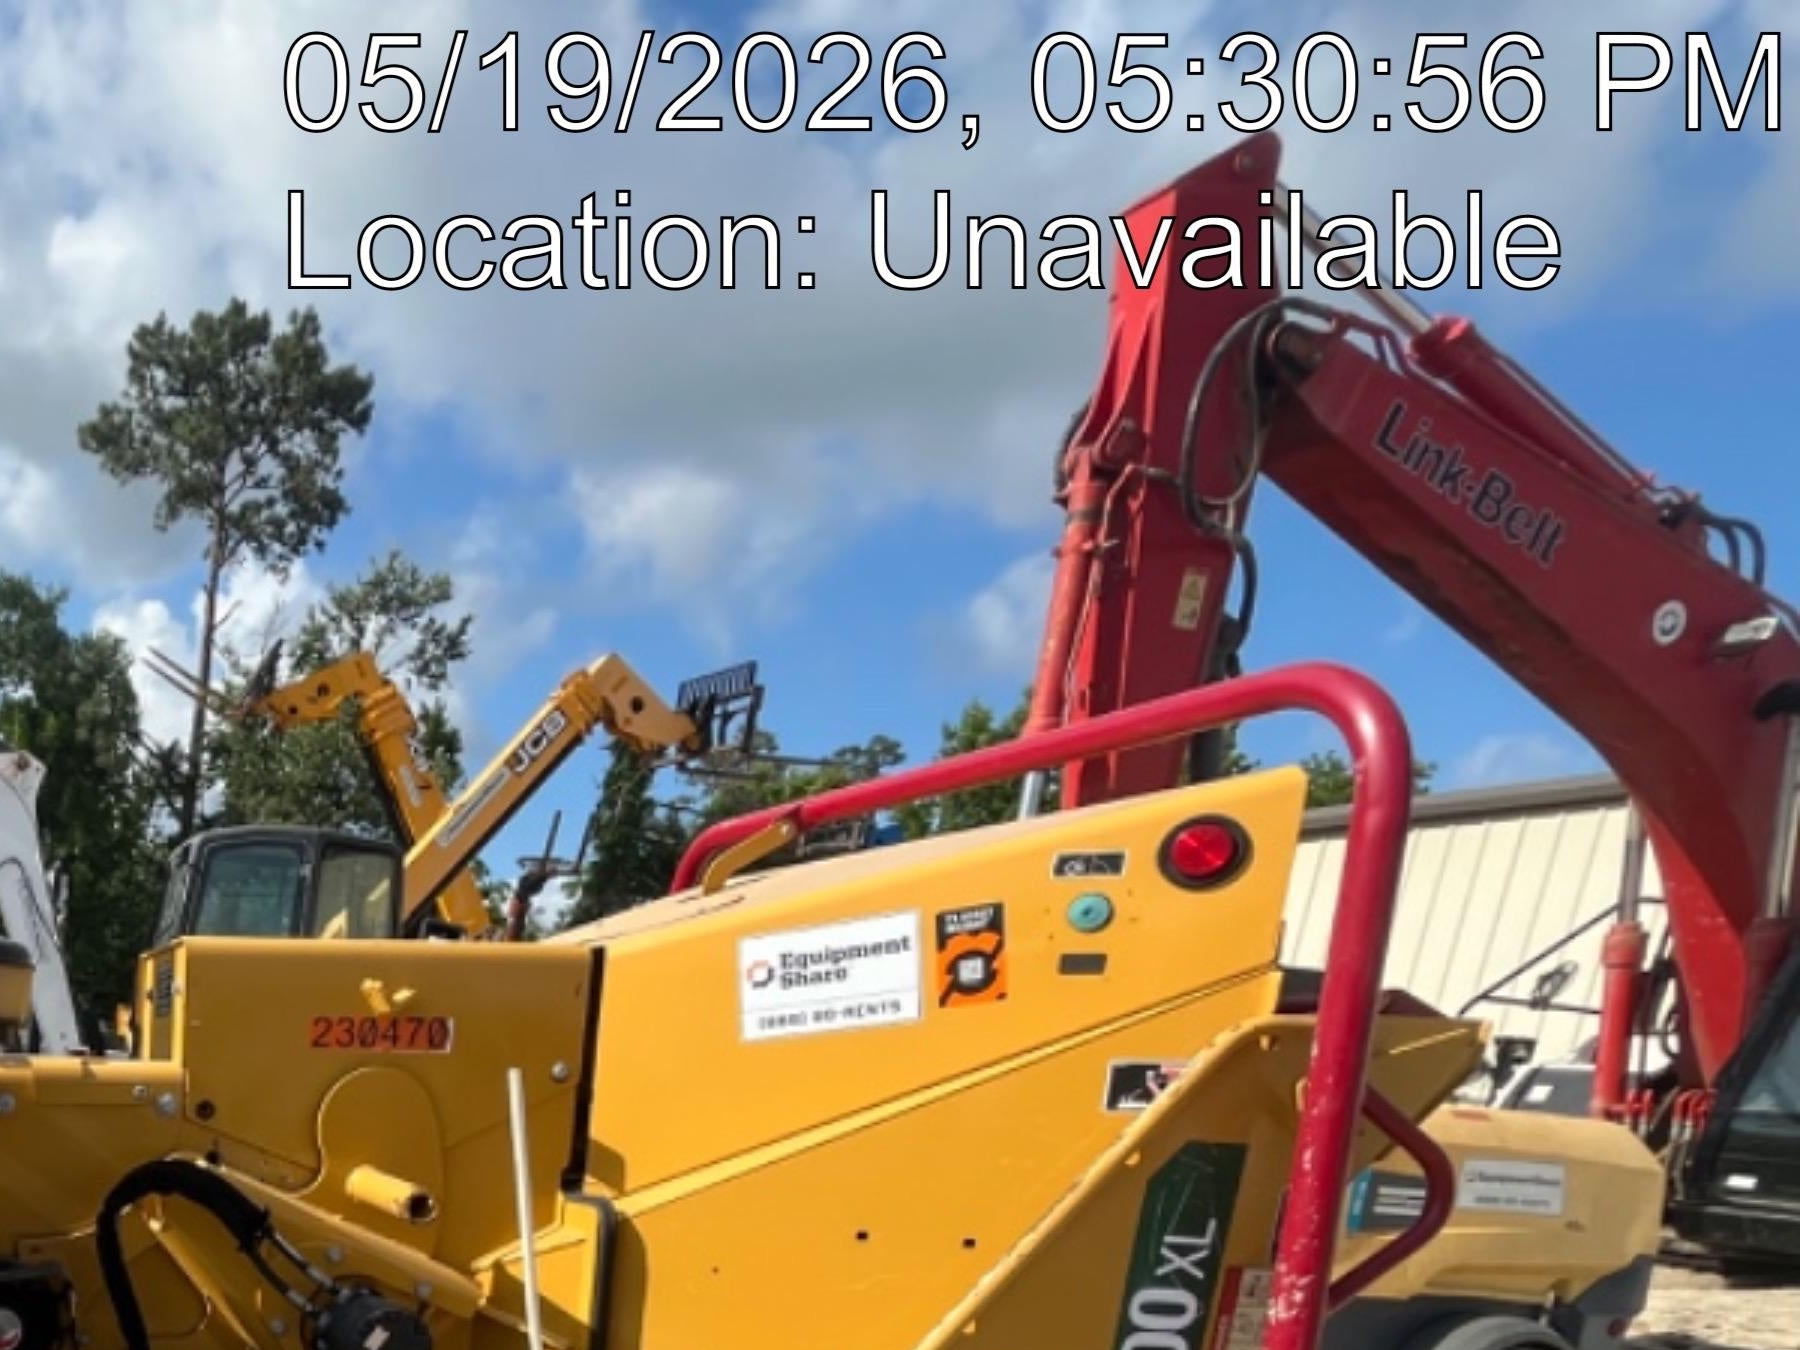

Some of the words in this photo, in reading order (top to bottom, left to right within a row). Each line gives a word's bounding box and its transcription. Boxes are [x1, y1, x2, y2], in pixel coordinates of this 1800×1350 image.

[512, 710, 566, 773] JCB
[780, 936, 911, 969] Equipment
[311, 1016, 448, 1049] 230470
